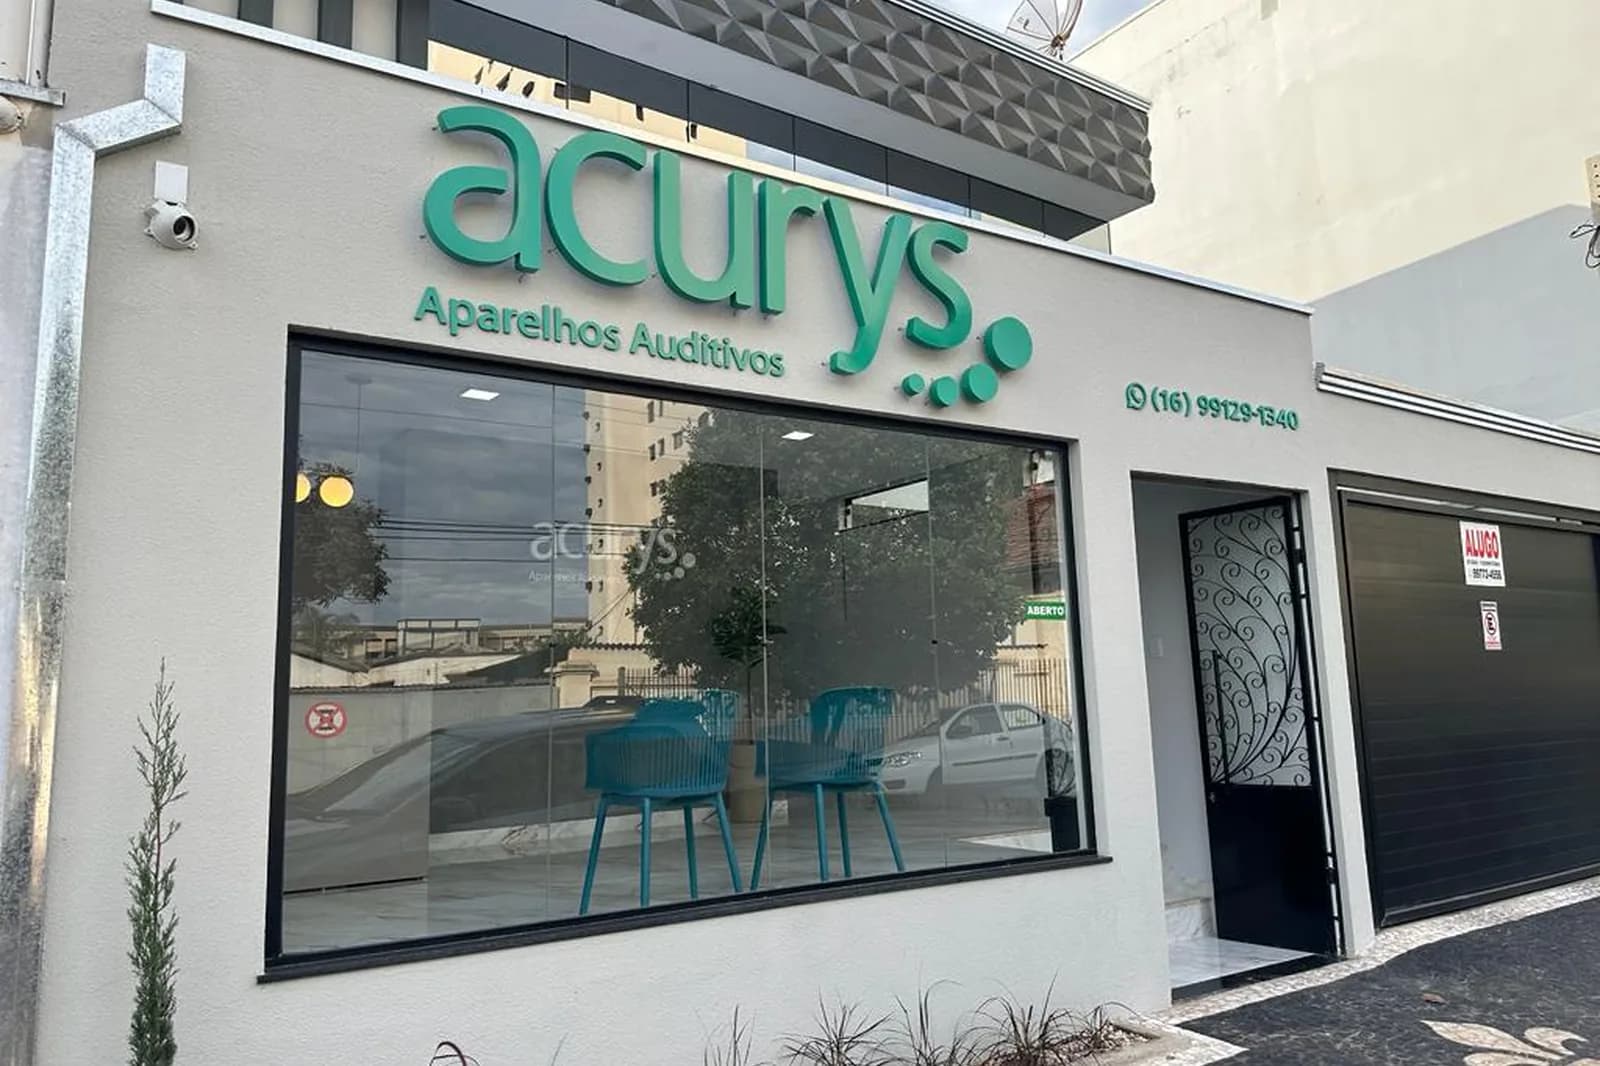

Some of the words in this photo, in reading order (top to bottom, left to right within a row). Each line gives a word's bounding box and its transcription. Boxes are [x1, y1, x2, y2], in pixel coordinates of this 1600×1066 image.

[423, 105, 972, 376] acurys
[414, 286, 621, 350] Aparelhos
[629, 322, 785, 377] Auditivos
[1151, 386, 1191, 417] (16)
[1196, 394, 1299, 430] 99129-1340
[530, 521, 678, 574] acuys
[1465, 529, 1499, 559] ALUGO
[1027, 605, 1064, 616] ABERTO
